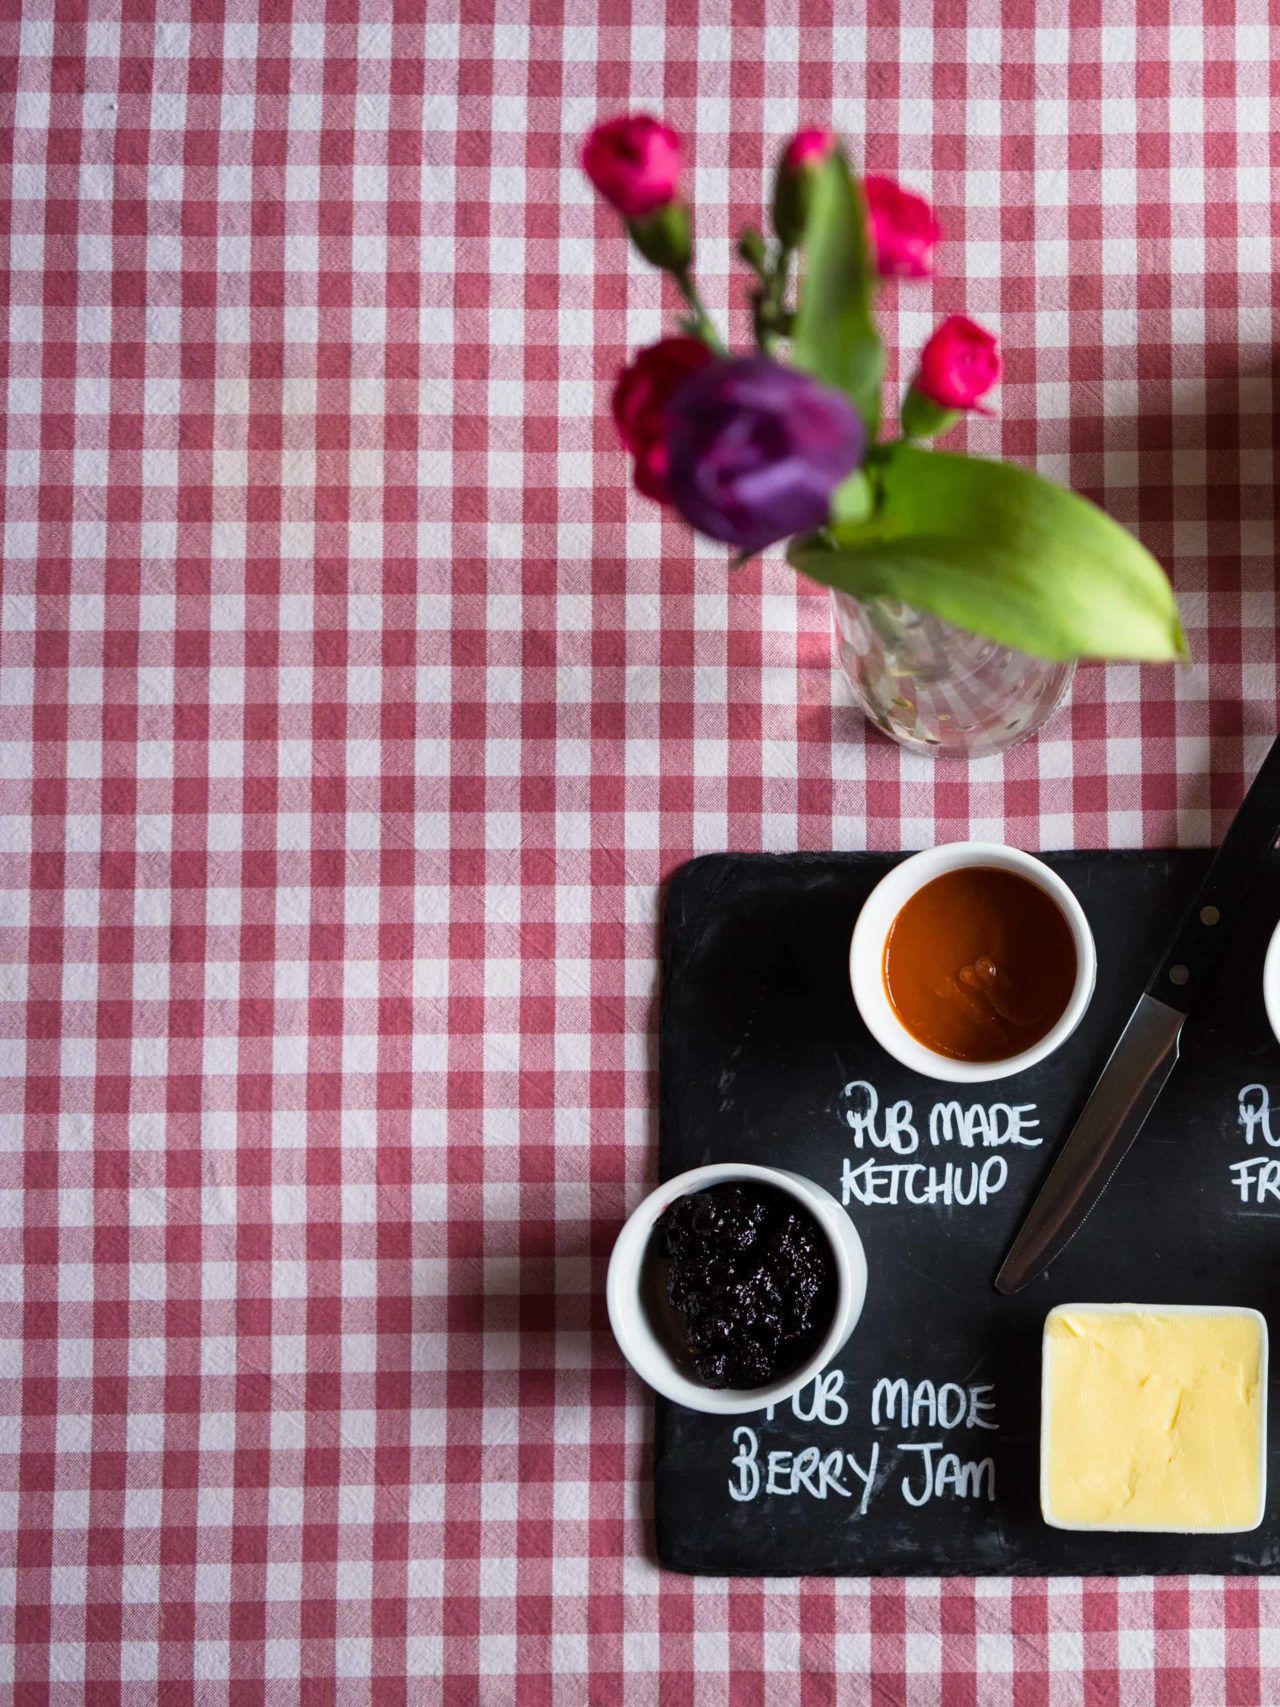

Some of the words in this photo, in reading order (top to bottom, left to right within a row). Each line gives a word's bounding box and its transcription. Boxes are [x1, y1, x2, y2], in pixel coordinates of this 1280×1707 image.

[845, 1080, 918, 1154] PUB
[929, 1100, 1043, 1147] MADE
[840, 1155, 1008, 1205] KETCHUP
[871, 1378, 999, 1428] MADE
[728, 1426, 879, 1515] BERRY
[897, 1442, 996, 1507] JAM
